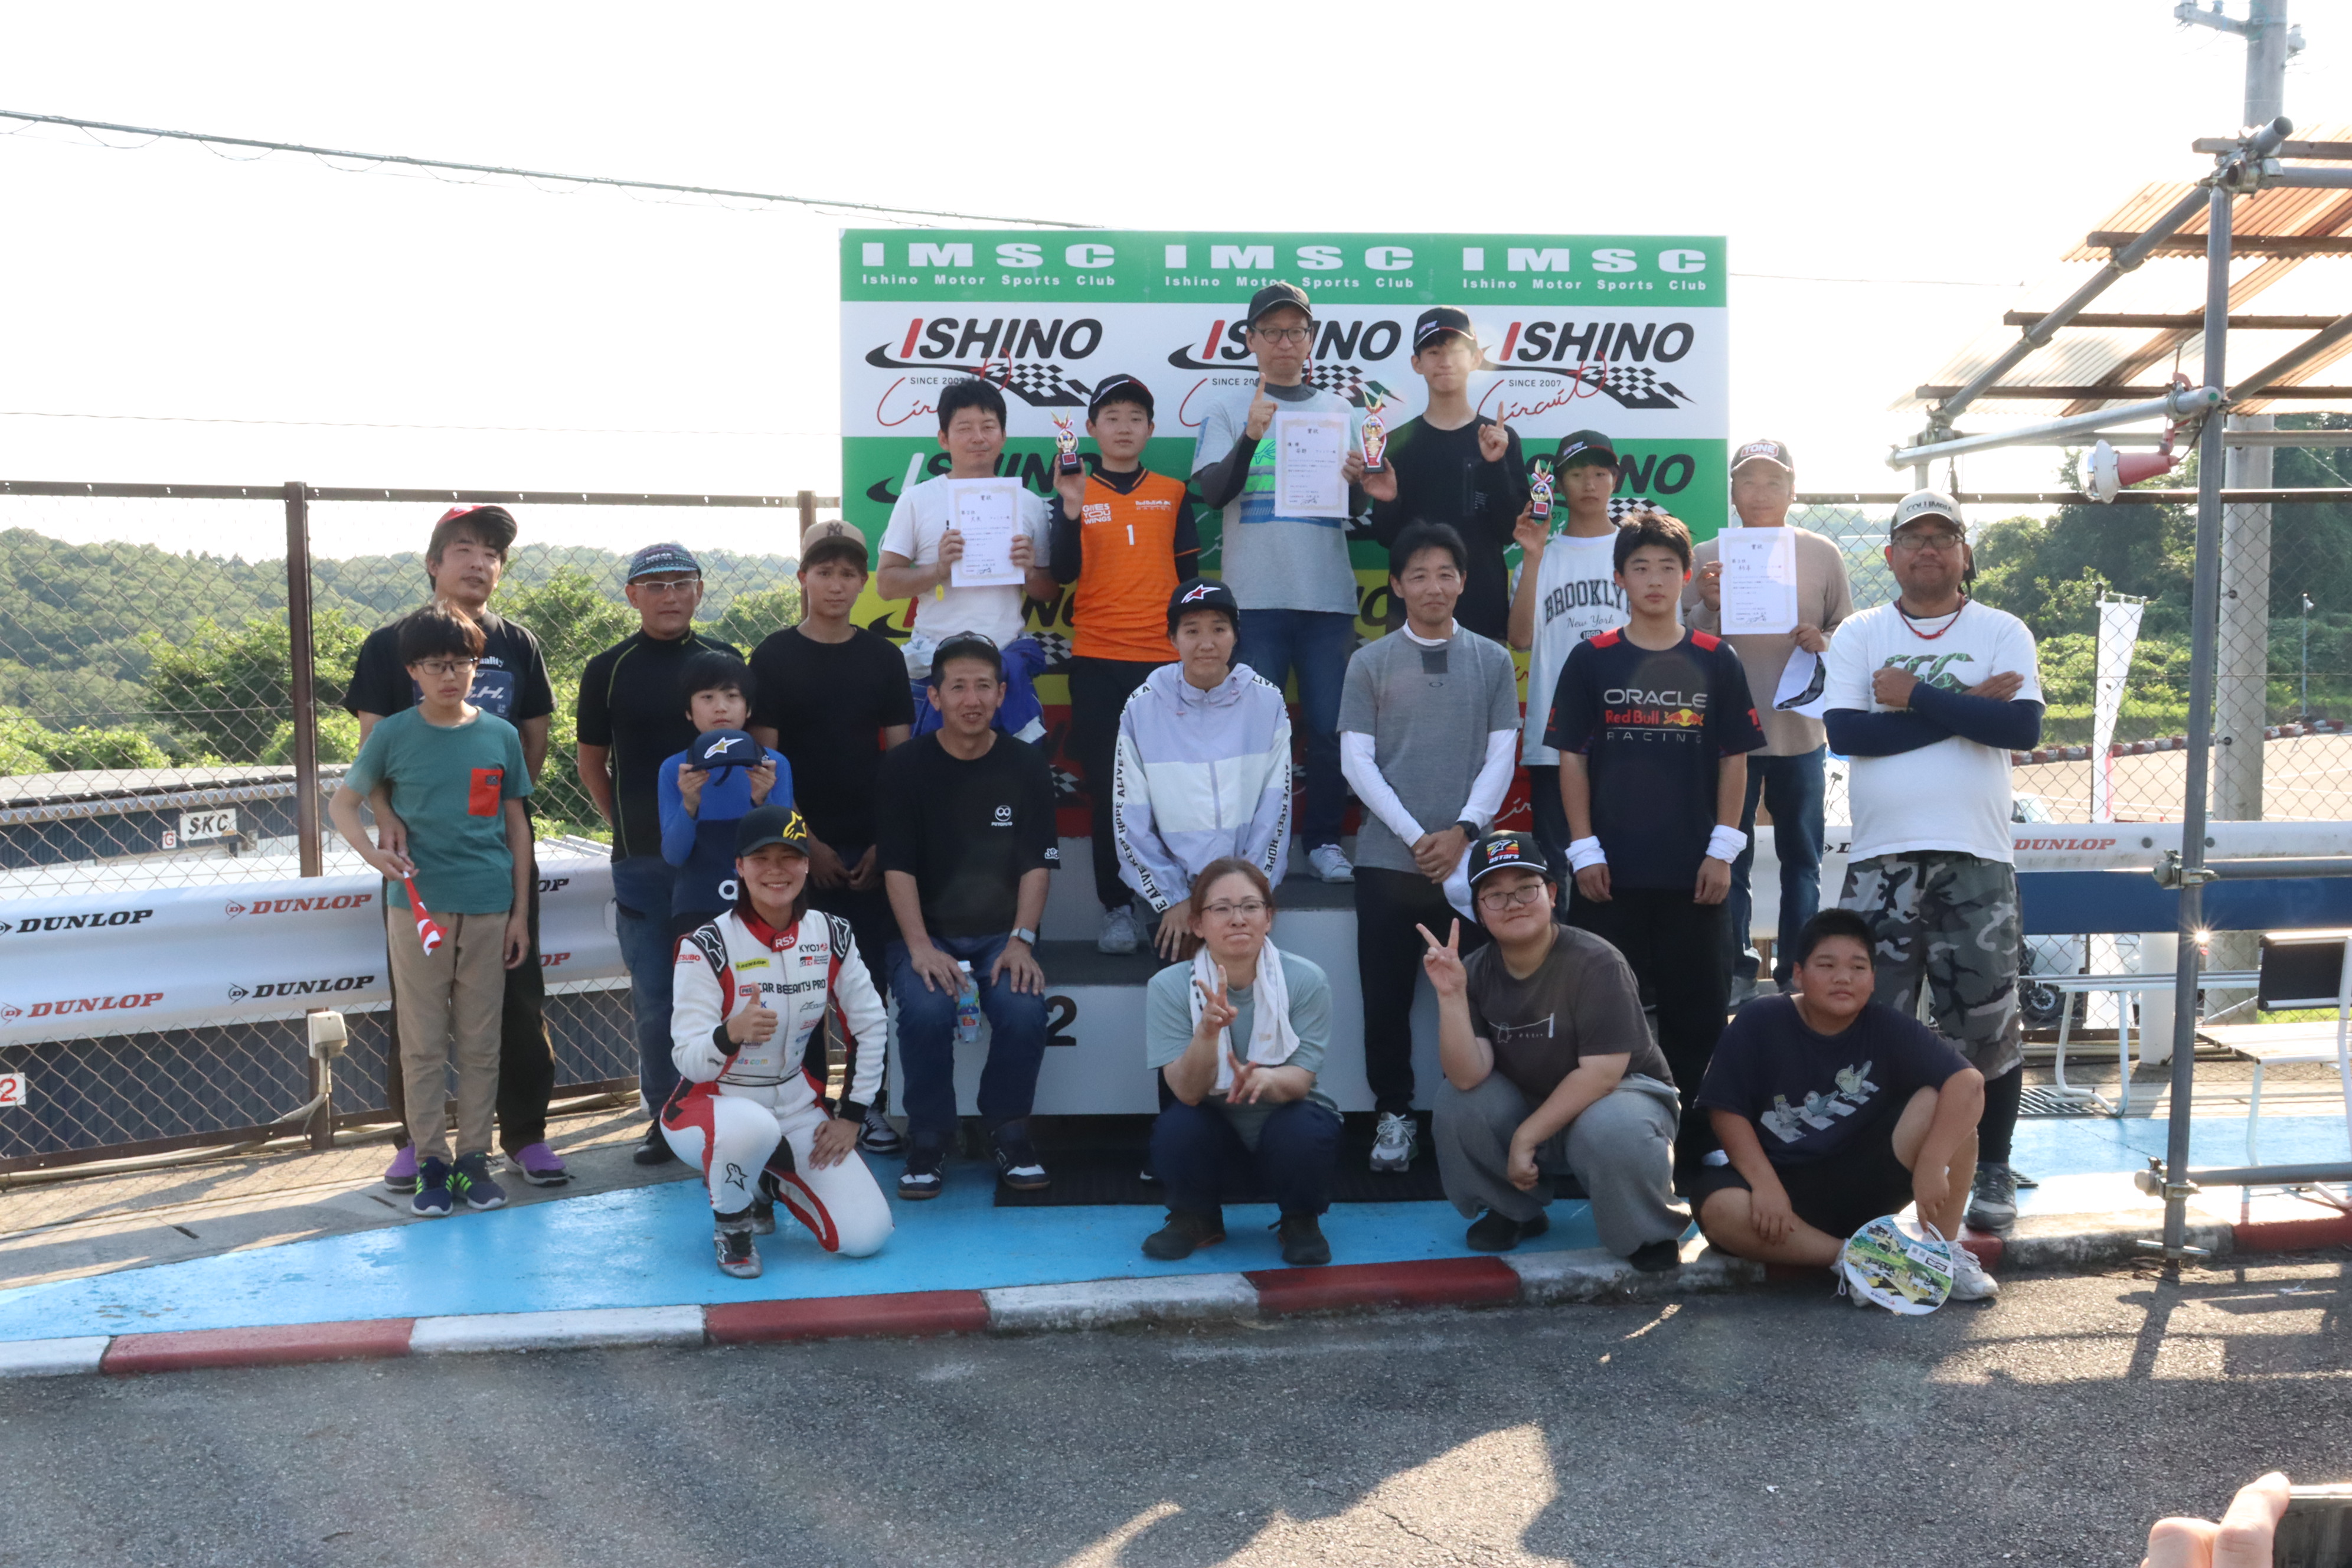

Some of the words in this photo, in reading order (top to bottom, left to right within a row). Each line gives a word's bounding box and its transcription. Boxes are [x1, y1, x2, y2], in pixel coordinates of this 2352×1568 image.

[863, 274, 918, 285] Ishino
[935, 275, 985, 285] Motor
[1002, 275, 1060, 288] Sports
[1076, 275, 1115, 286] Club
[1165, 276, 1220, 286] Ishino
[1302, 277, 1360, 289] Sports
[1376, 277, 1414, 288] Club
[1463, 279, 1517, 289] Ishino
[1533, 279, 1582, 289] Motor
[1597, 279, 1653, 292] Sports
[1669, 280, 1707, 290] Club
[900, 318, 1103, 359] ISHINO
[1500, 321, 1694, 363] ISHINO
[1743, 443, 1775, 453] TONE
[1083, 510, 1111, 518] YOU
[1084, 515, 1112, 525] WINGS
[1126, 524, 1135, 545] 1
[1567, 617, 1588, 628] New
[1590, 614, 1614, 628] York
[1604, 688, 1708, 708] ORACLE
[1605, 710, 1631, 724] Red
[1633, 710, 1660, 724] Bull
[1607, 731, 1701, 744] RACING
[188, 814, 229, 836] SKC
[164, 832, 175, 847] G
[2014, 839, 2116, 850] DUNLOP
[1264, 839, 1279, 873] HOPE
[1138, 867, 1162, 899] ALIVE
[249, 894, 373, 916] DUNLOP
[16, 909, 153, 935] DUNLOP
[775, 934, 795, 948] RSS
[251, 975, 375, 998] DUNLOP
[813, 979, 827, 990] PRO
[27, 992, 164, 1018] DUNLOP
[1046, 995, 1077, 1047] 2
